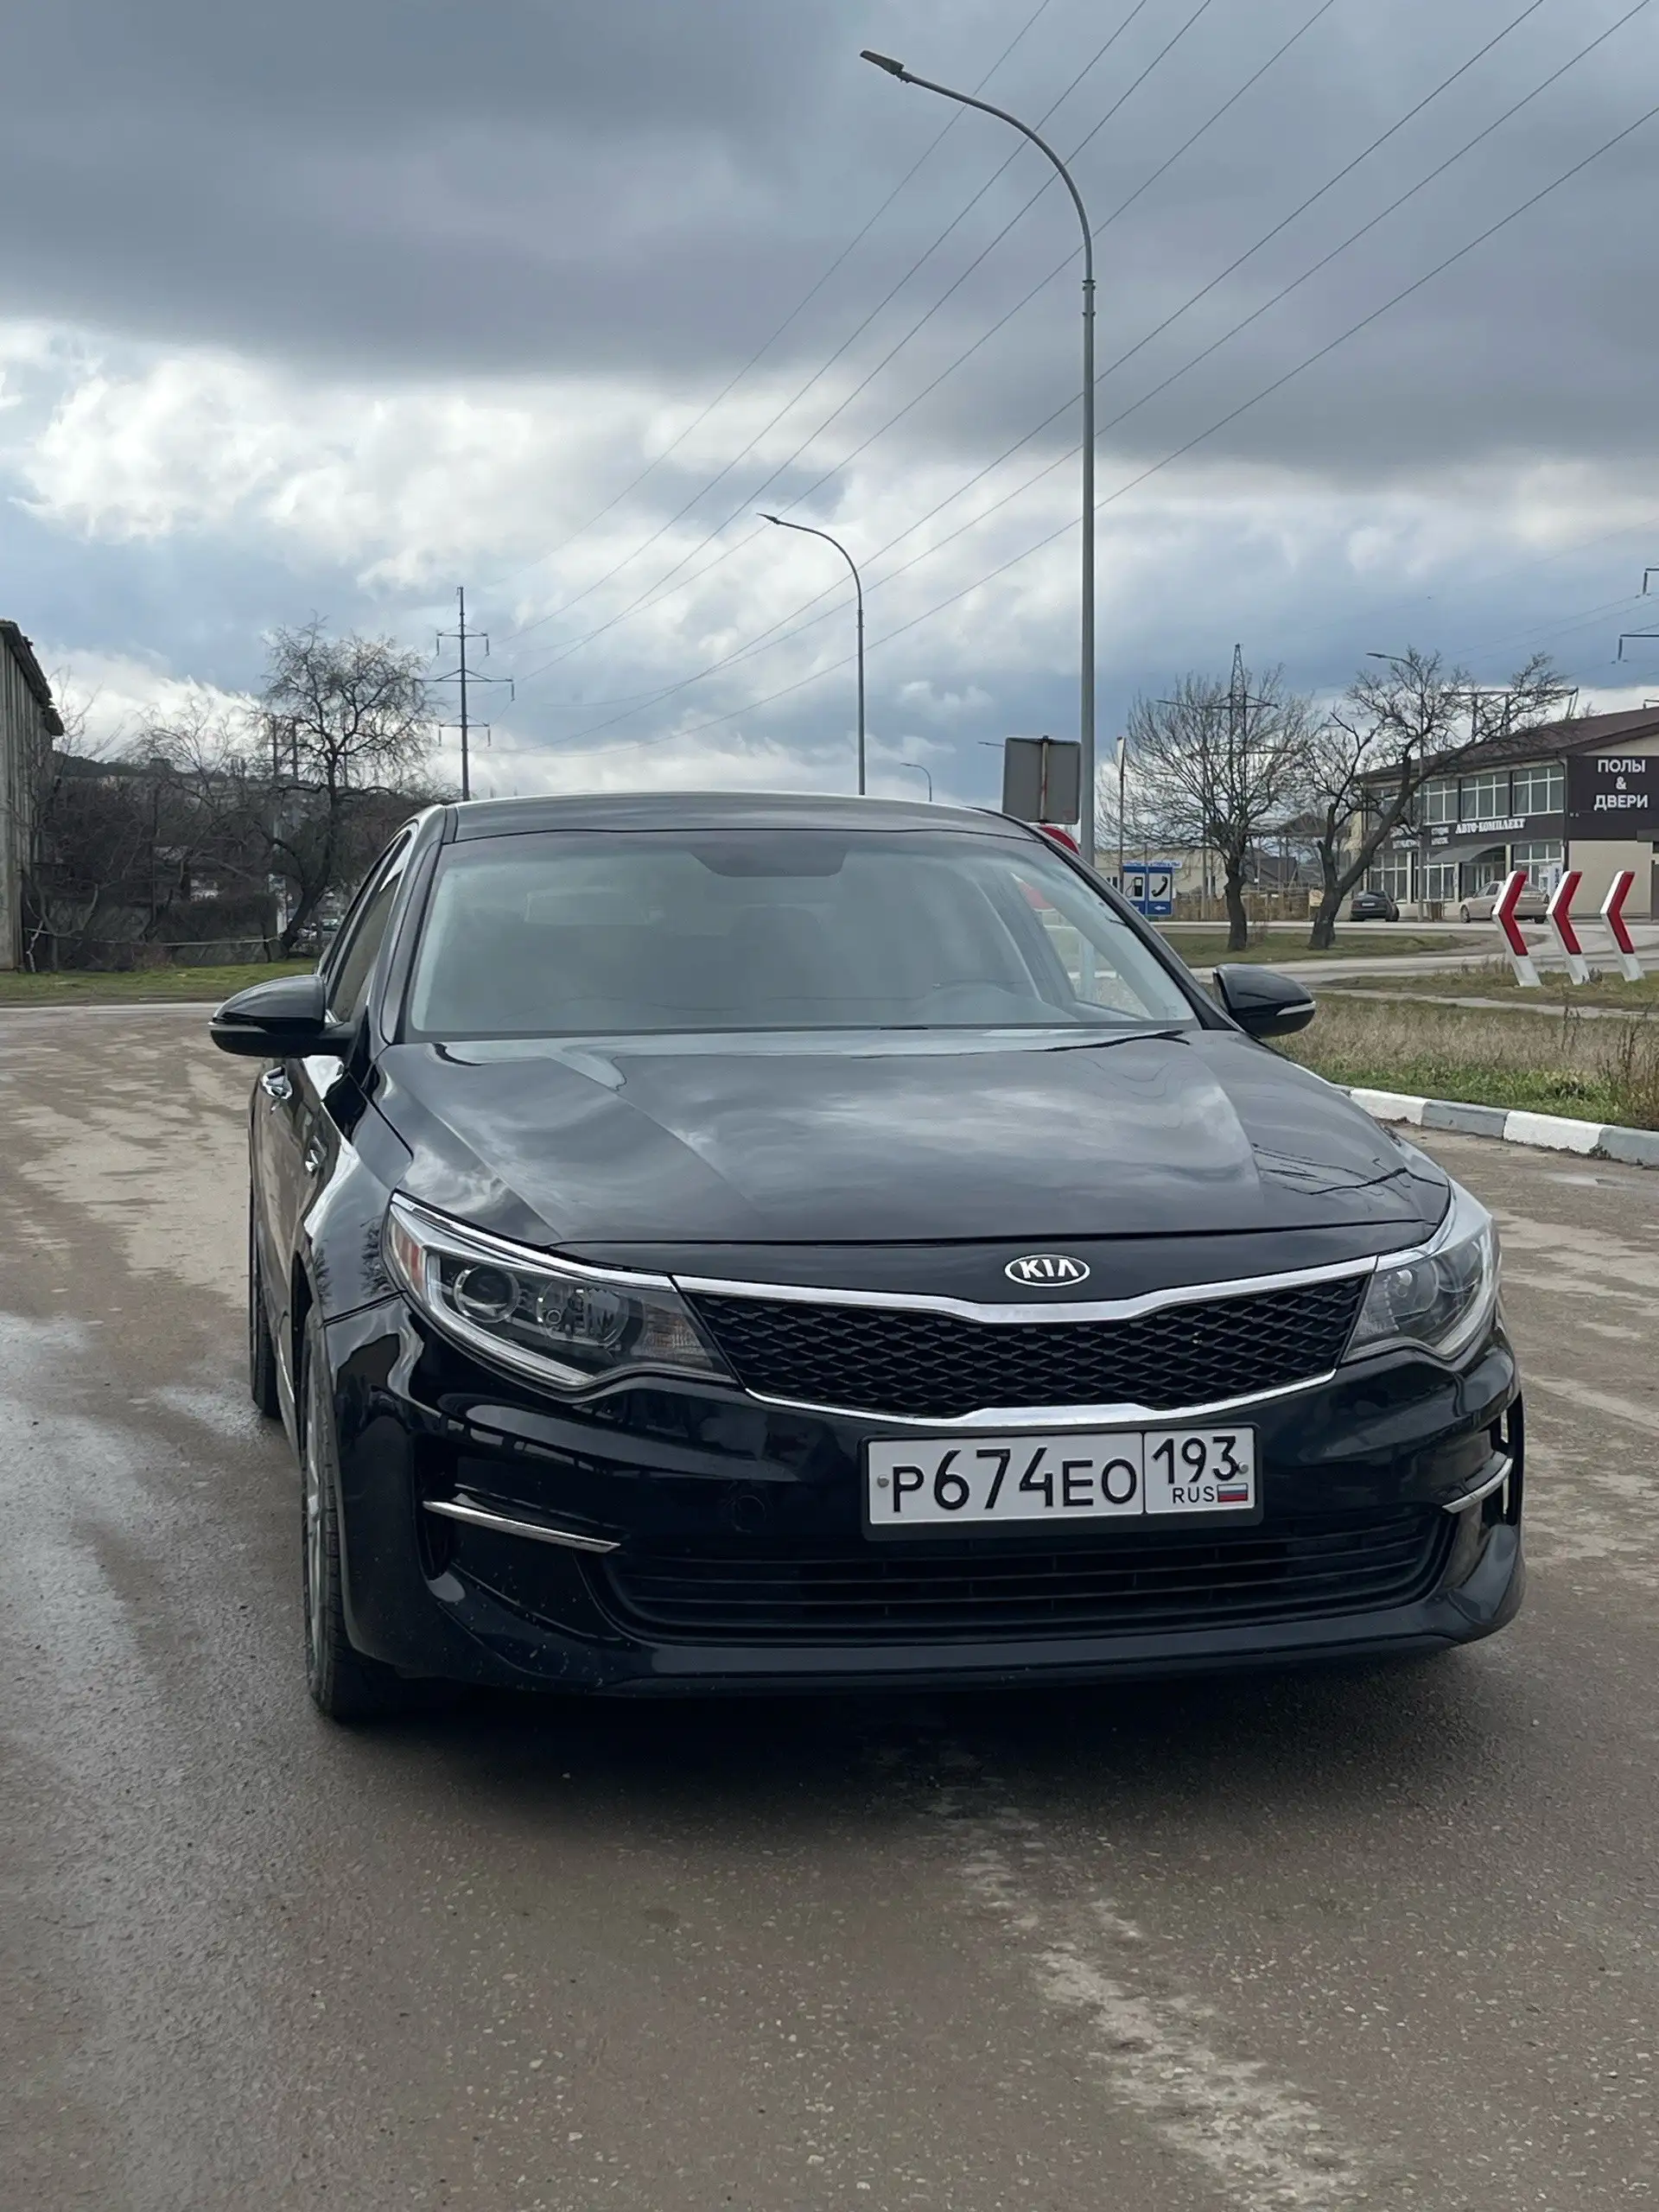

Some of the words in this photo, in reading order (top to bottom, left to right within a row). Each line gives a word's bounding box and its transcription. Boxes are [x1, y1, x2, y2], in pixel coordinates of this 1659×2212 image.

[1597, 759, 1645, 773] ПОЛЫ
[1615, 776, 1627, 790] &
[1593, 794, 1649, 811] ДВЕРИ
[1019, 1258, 1079, 1279] KIA
[1152, 1435, 1238, 1484] 193
[1172, 1486, 1215, 1503] RUS
